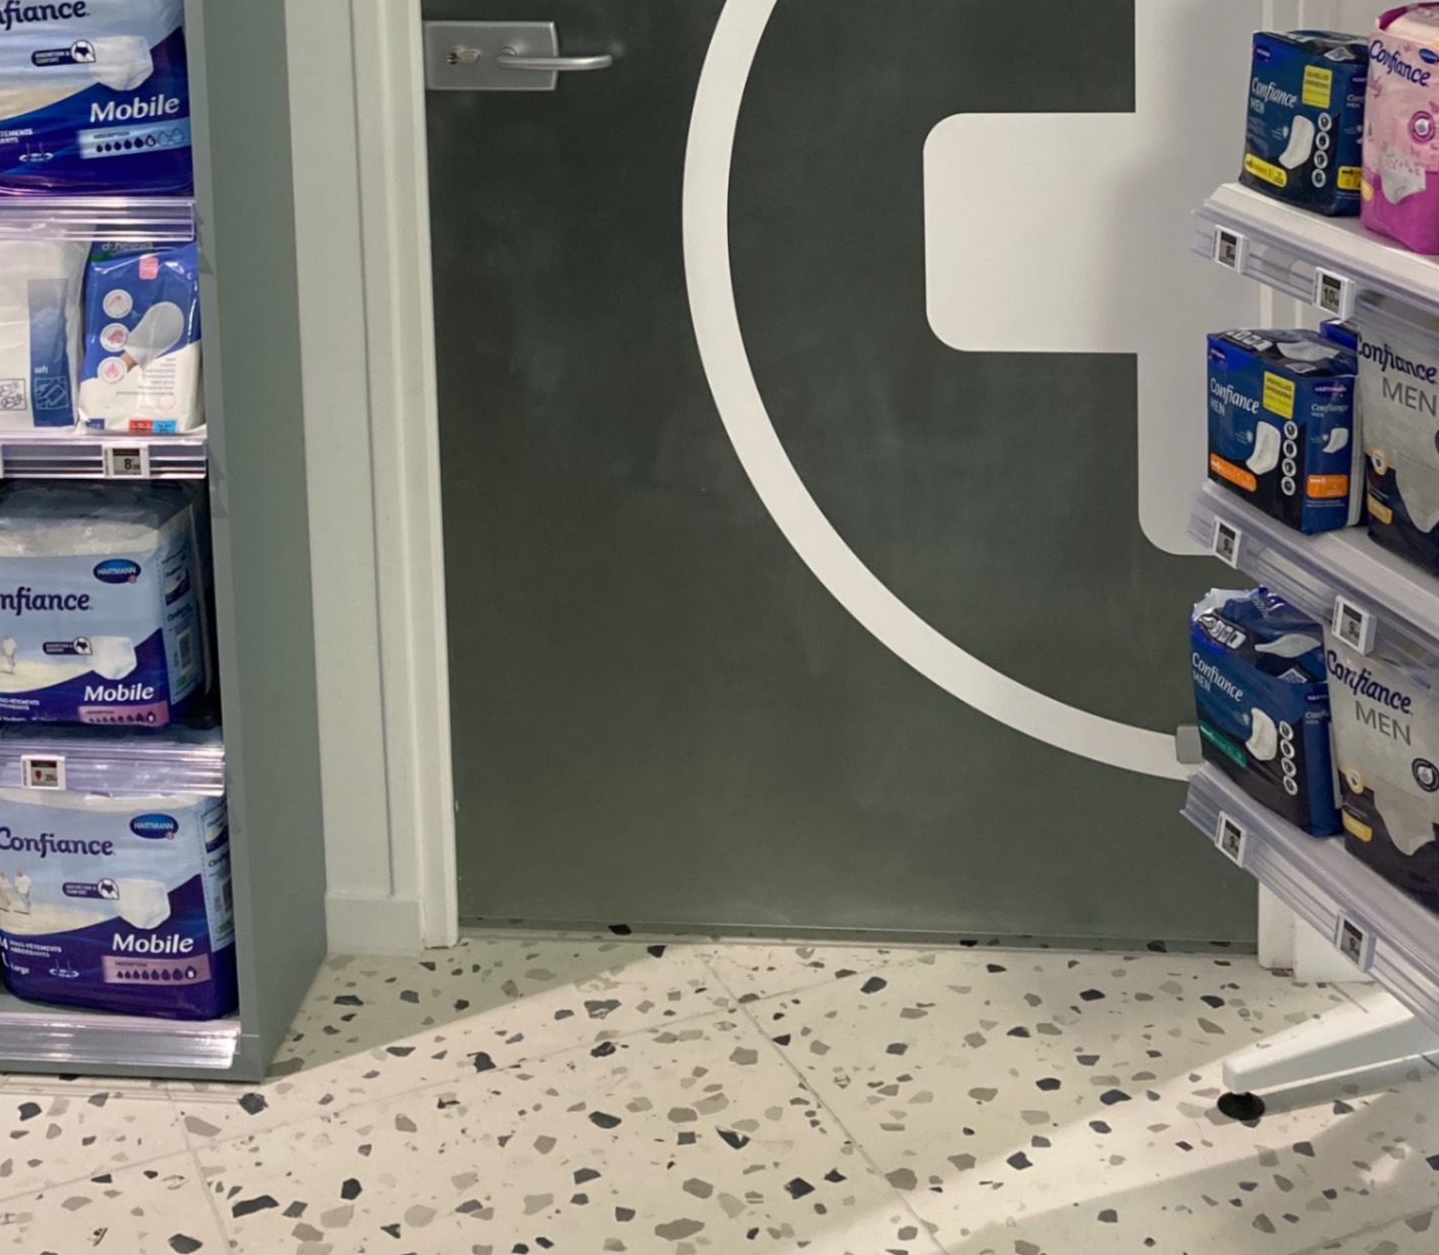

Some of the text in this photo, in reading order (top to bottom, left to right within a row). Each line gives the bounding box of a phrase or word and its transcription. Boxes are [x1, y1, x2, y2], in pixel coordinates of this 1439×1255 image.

[1368, 40, 1431, 88] Confiance
[90, 94, 180, 123] Mobile
[1251, 77, 1298, 109] Confiance
[1323, 288, 1335, 303] 10
[1210, 377, 1261, 415] Confiance
[1382, 377, 1438, 417] MEN
[83, 683, 155, 702] Mobile
[1192, 651, 1244, 703] Confiance
[1326, 650, 1413, 715] Confiance
[1355, 700, 1413, 746] MEN
[112, 933, 194, 954] Mobile
